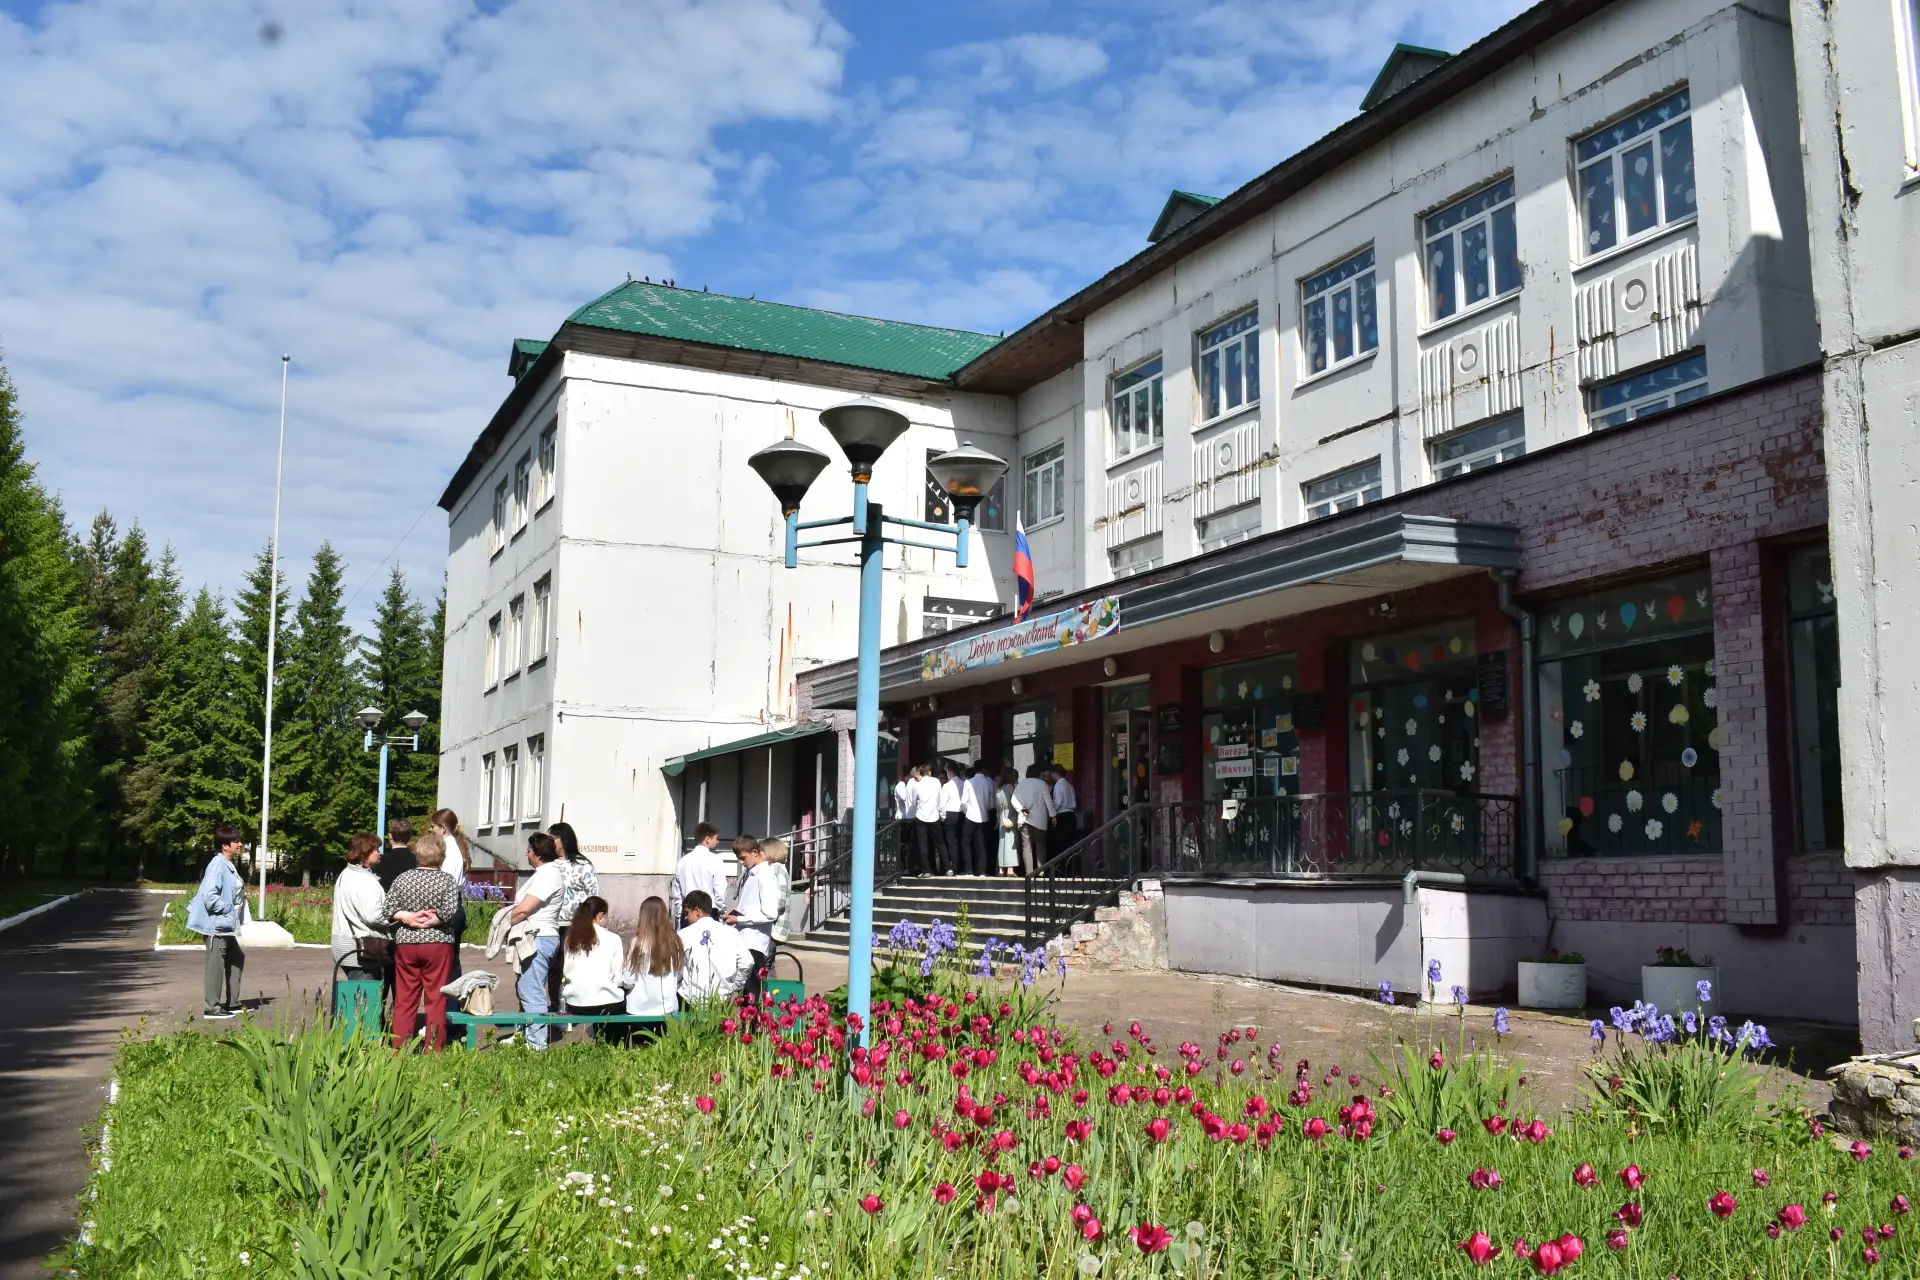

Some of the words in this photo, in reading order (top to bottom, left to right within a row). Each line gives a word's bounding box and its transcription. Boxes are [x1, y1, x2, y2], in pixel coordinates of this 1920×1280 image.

[968, 635, 995, 662] Добро
[997, 616, 1059, 651] пожаловать!
[1218, 747, 1248, 758] Лагерь
[1217, 764, 1252, 776] «Мечта»
